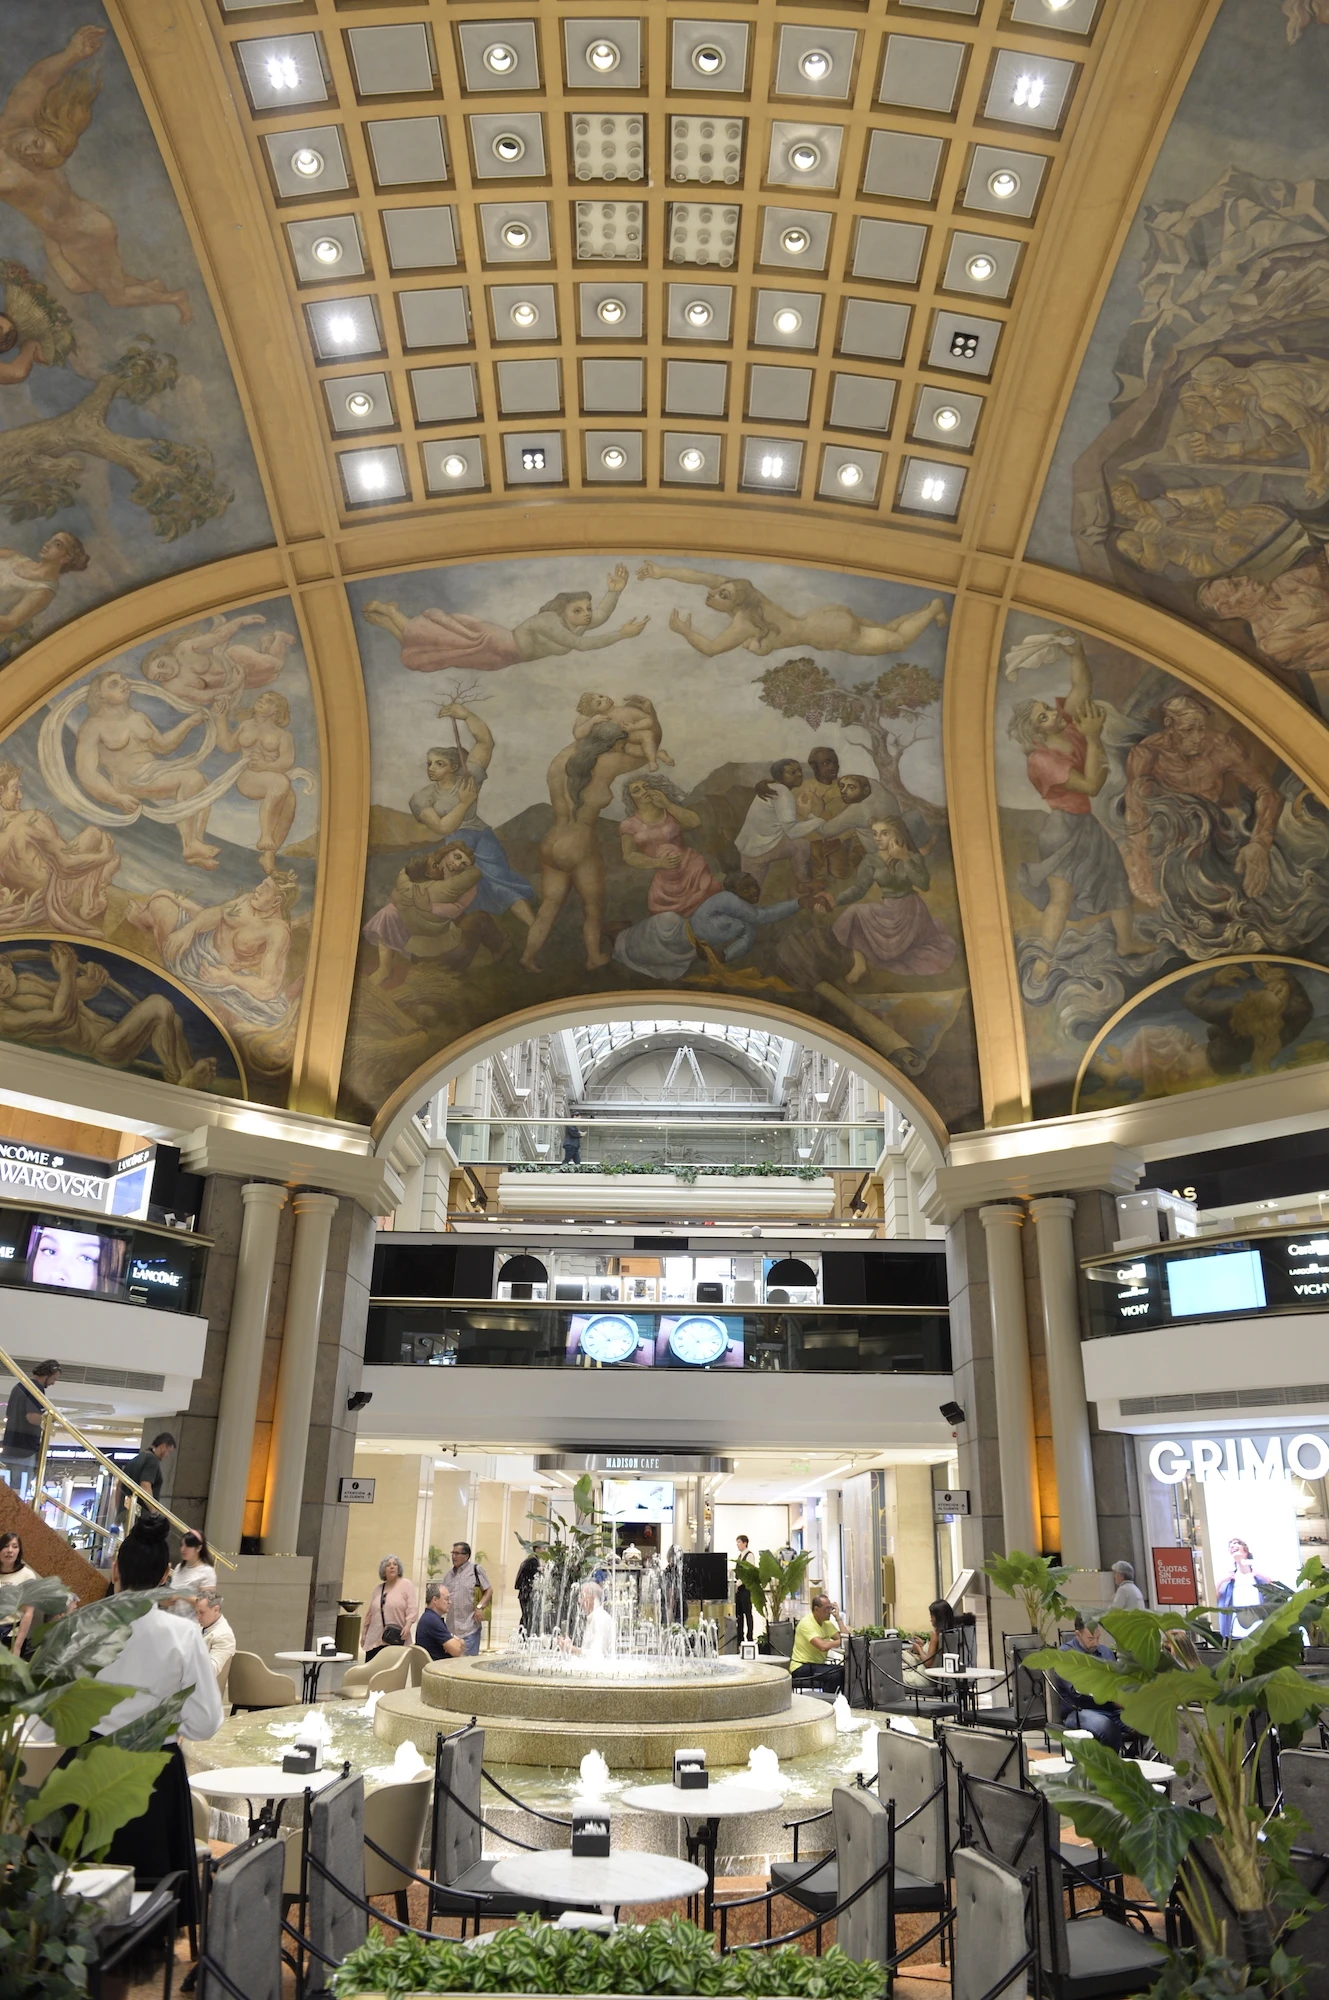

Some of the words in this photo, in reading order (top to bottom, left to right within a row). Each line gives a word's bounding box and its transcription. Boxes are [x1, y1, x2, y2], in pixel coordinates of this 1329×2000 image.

[1120, 1303, 1149, 1317] VICHY
[606, 1457, 638, 1468] MADISON
[640, 1458, 659, 1469] CAFE
[1149, 1433, 1329, 1484] GRIMO
[1160, 1577, 1192, 1585] INTERÉS
